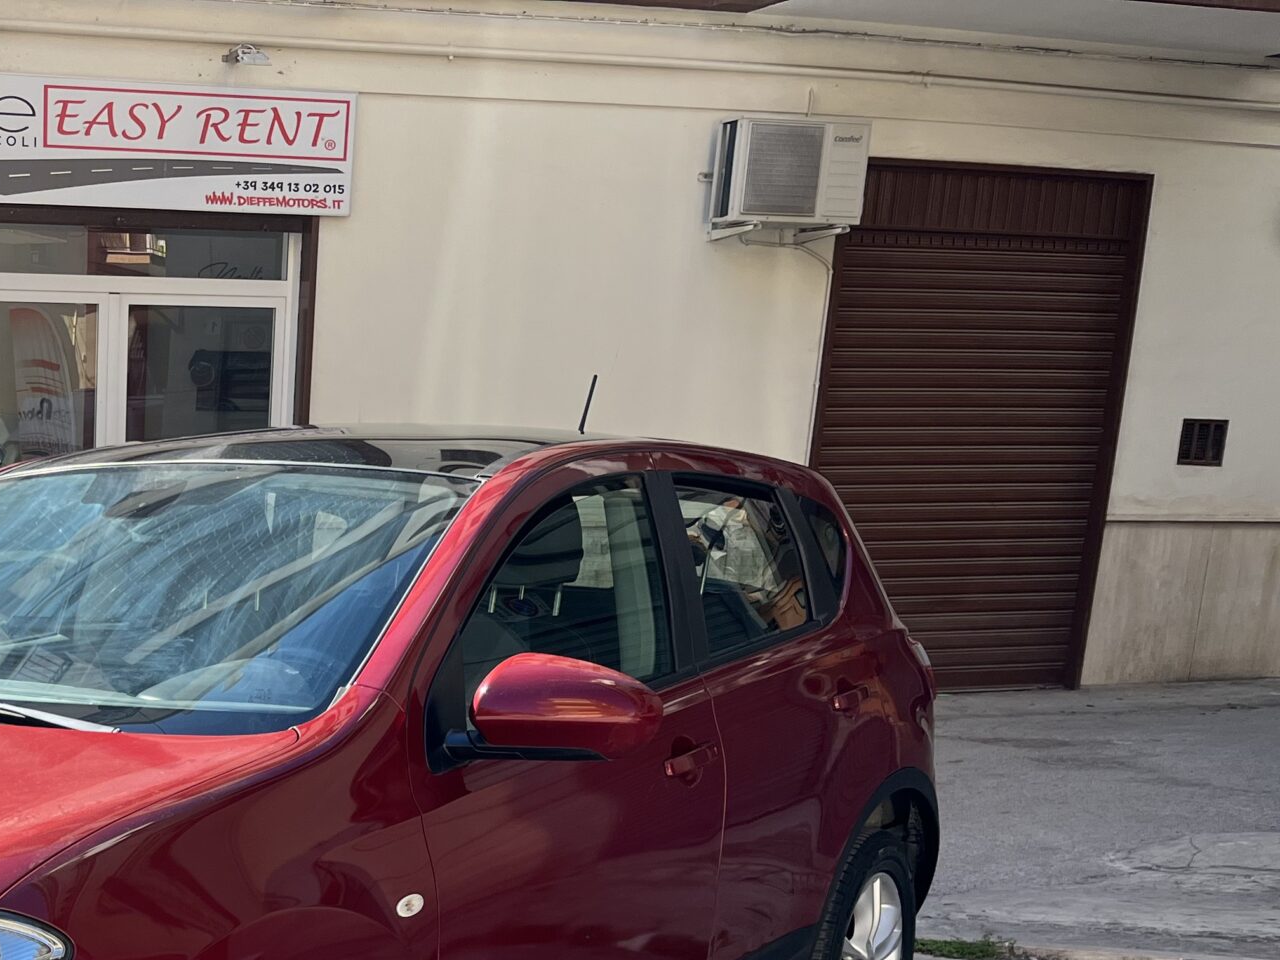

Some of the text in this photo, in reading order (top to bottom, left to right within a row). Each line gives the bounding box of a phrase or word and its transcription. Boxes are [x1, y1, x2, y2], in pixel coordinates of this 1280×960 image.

[54, 99, 341, 147] EASY RENT
[235, 180, 345, 195] +39 349 13 02 015
